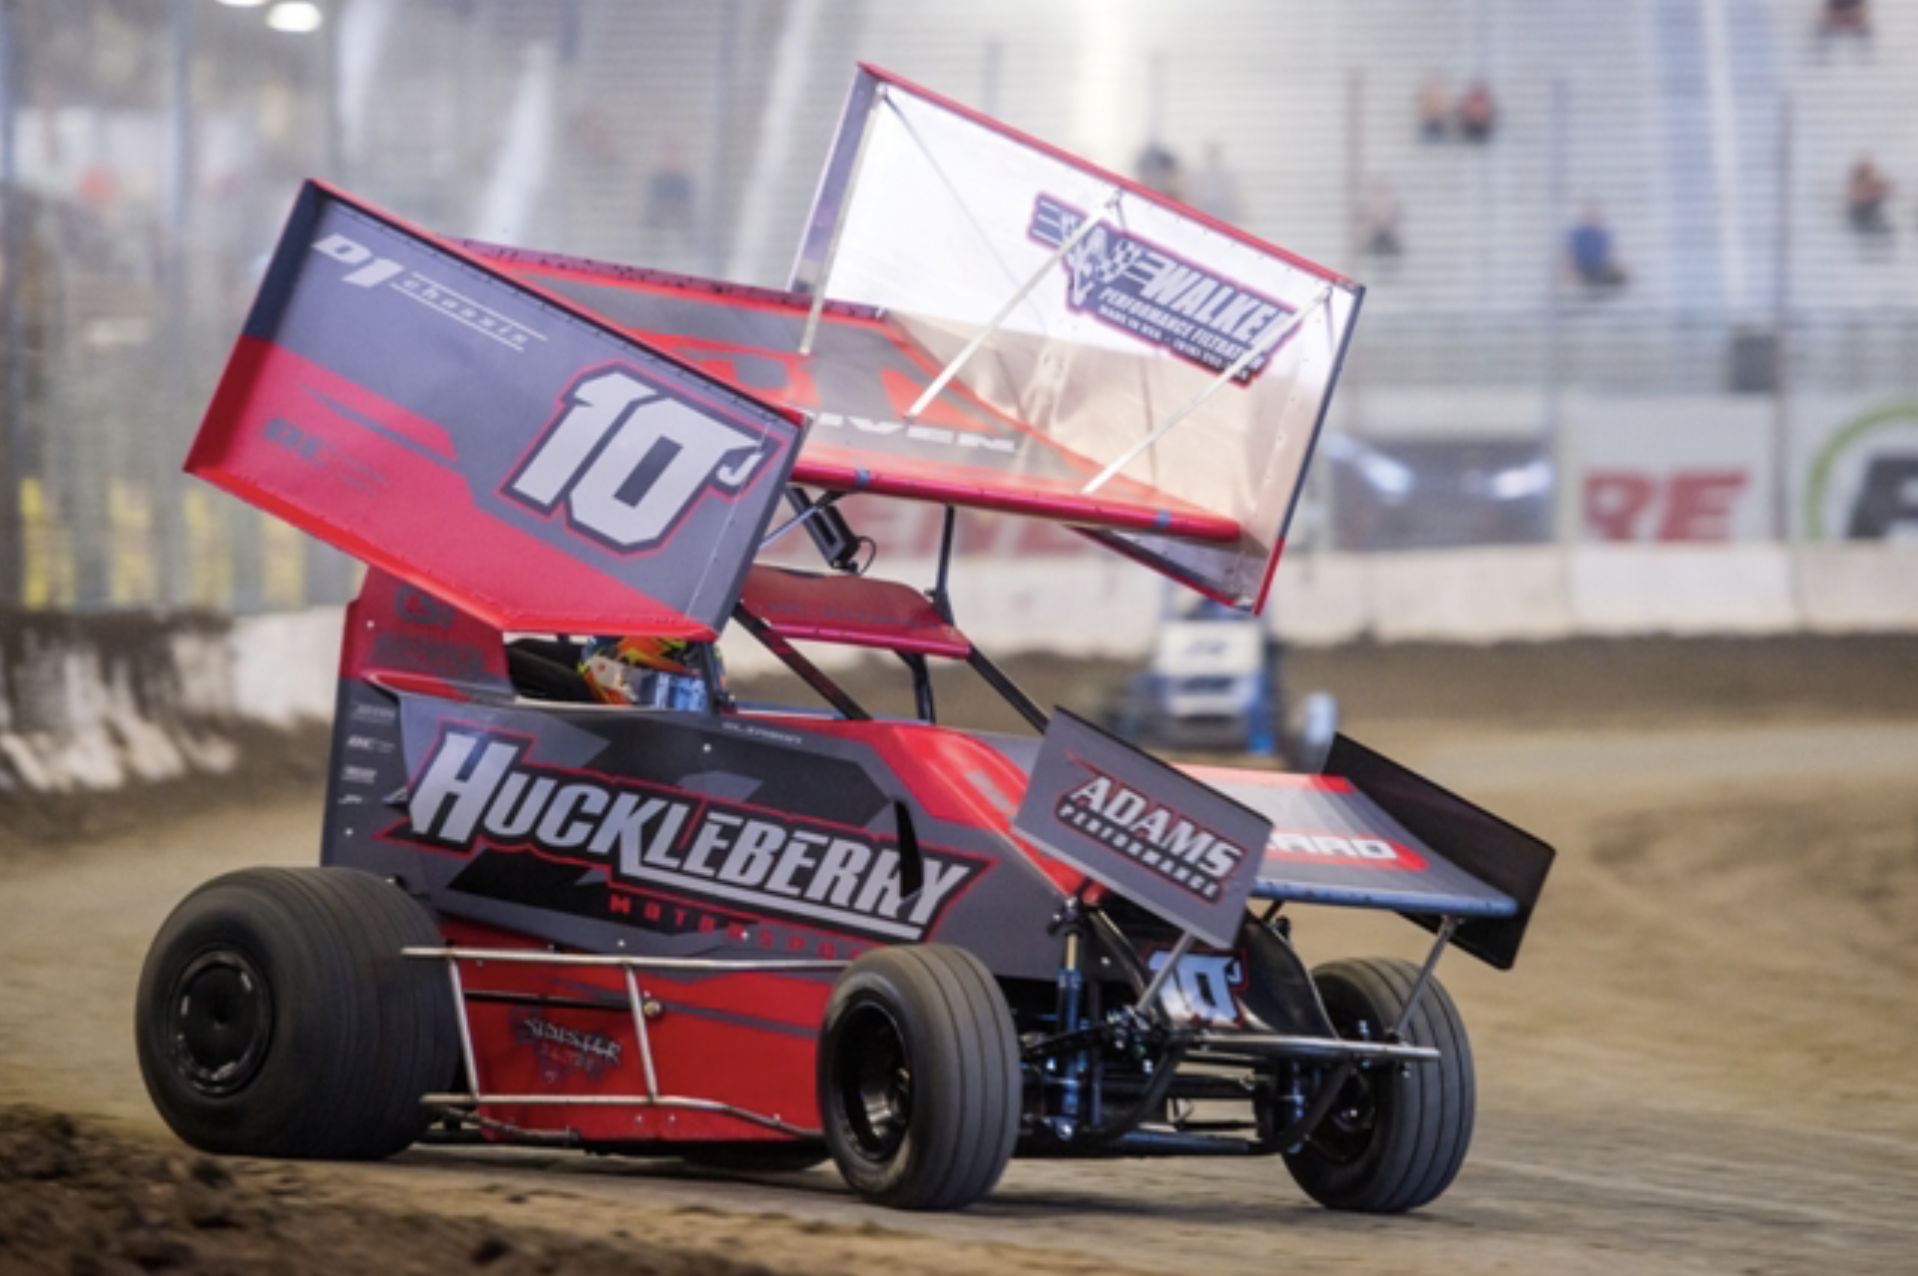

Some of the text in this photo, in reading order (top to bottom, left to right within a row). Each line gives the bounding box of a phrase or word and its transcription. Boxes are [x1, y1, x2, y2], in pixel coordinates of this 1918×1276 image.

[311, 232, 405, 288] D1
[1098, 287, 1196, 337] PERFORMANCE
[1190, 328, 1266, 371] FILTRATN
[804, 409, 1016, 452] IVEN
[1058, 804, 1219, 898] PERFORMANCE
[1069, 776, 1244, 877] ADAMS
